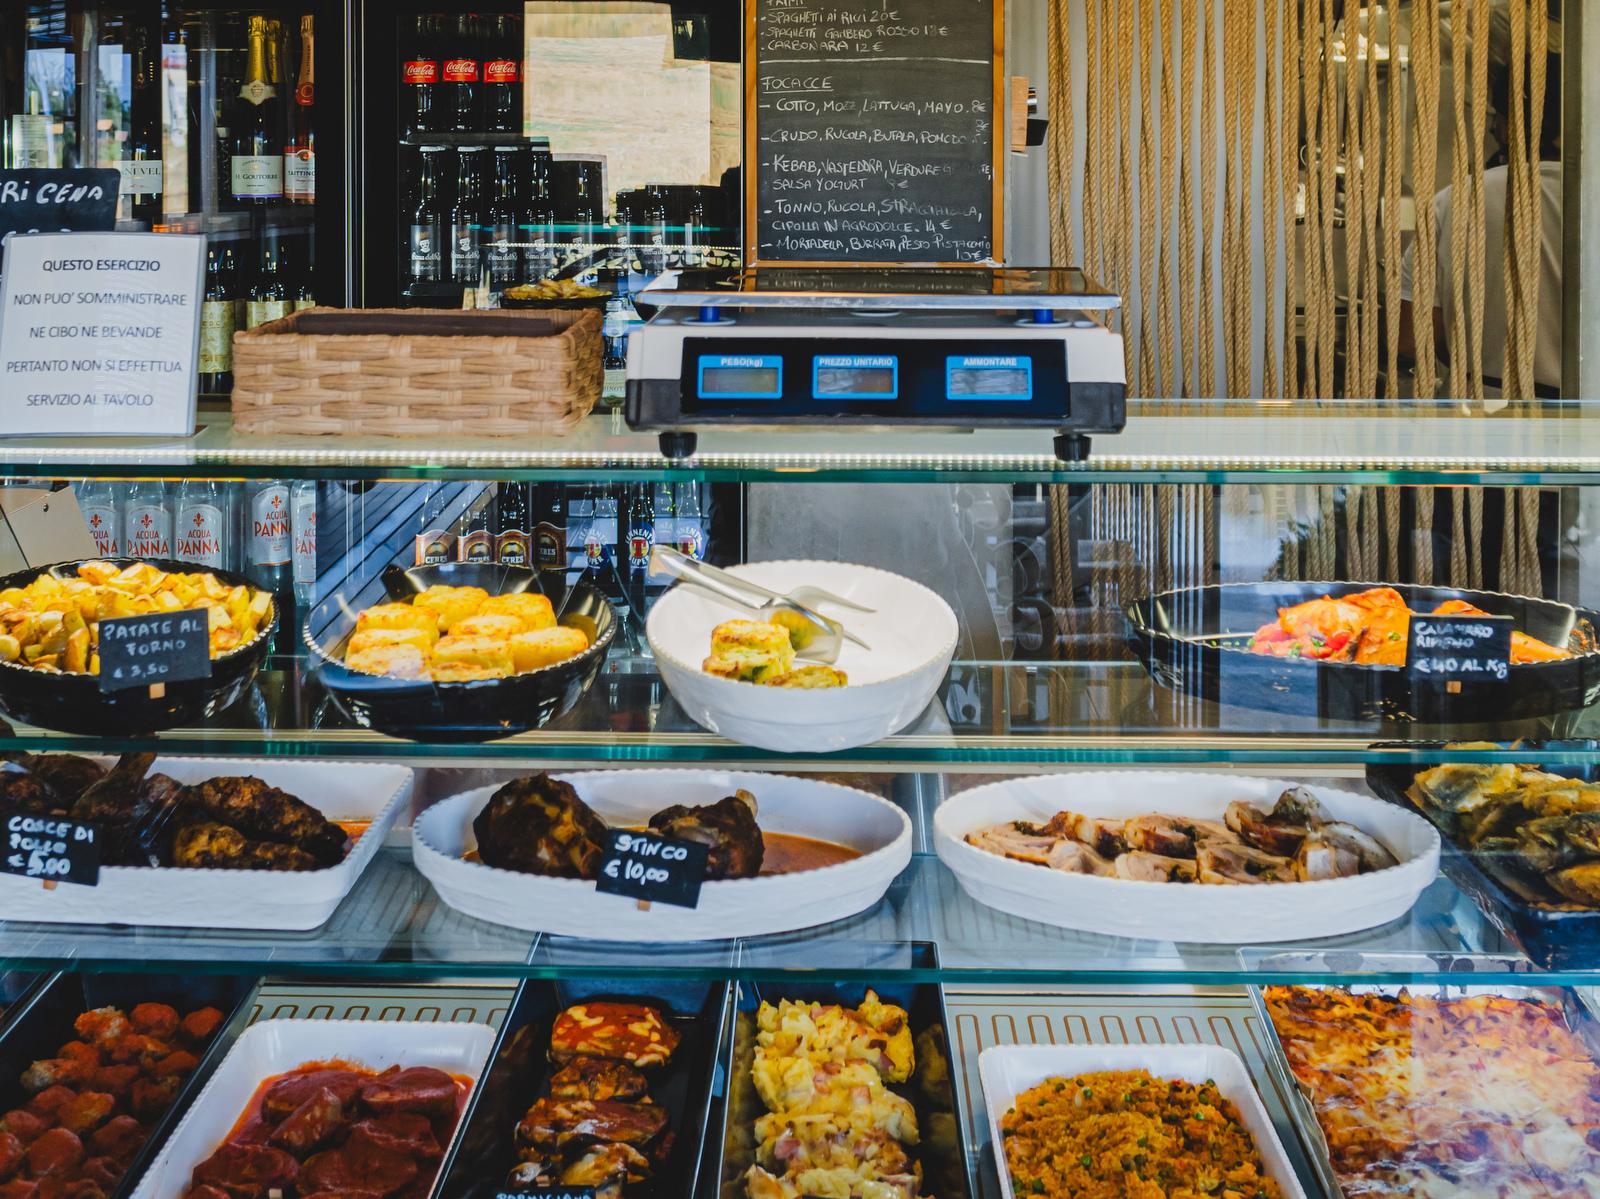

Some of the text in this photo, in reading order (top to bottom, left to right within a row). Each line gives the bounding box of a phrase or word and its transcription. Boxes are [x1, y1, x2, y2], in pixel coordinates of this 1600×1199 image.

[768, 40, 848, 52] CARBONARA
[760, 76, 832, 90] FOCACCE
[773, 179, 812, 190] SALSA
[817, 178, 867, 191] YOGURT
[36, 183, 103, 204] CENA
[772, 220, 820, 231] CIPOLLA
[42, 259, 161, 272] QUESTO ESERCIZIO
[14, 293, 42, 306] NON
[78, 292, 188, 306] SOMMINISTRARE
[30, 326, 163, 338] NE CIBO NE BEVANDE
[7, 360, 183, 373] PERTANTO NON SI EFFETTUA
[819, 358, 893, 367] PREZZO UNITARIO
[963, 357, 1017, 366] AMMONTARE
[27, 394, 81, 406] SERVIZIO
[103, 394, 154, 406] TAVOLO
[266, 511, 288, 521] ACQUA
[136, 530, 159, 540] ACQUA
[188, 529, 211, 539] ACQUA
[128, 539, 169, 557] PANNA
[177, 538, 220, 556] PANNA
[104, 619, 202, 640] PATATE AL
[126, 640, 186, 656] FORNO
[1461, 659, 1484, 672] AL
[8, 816, 94, 843] COSCE DI
